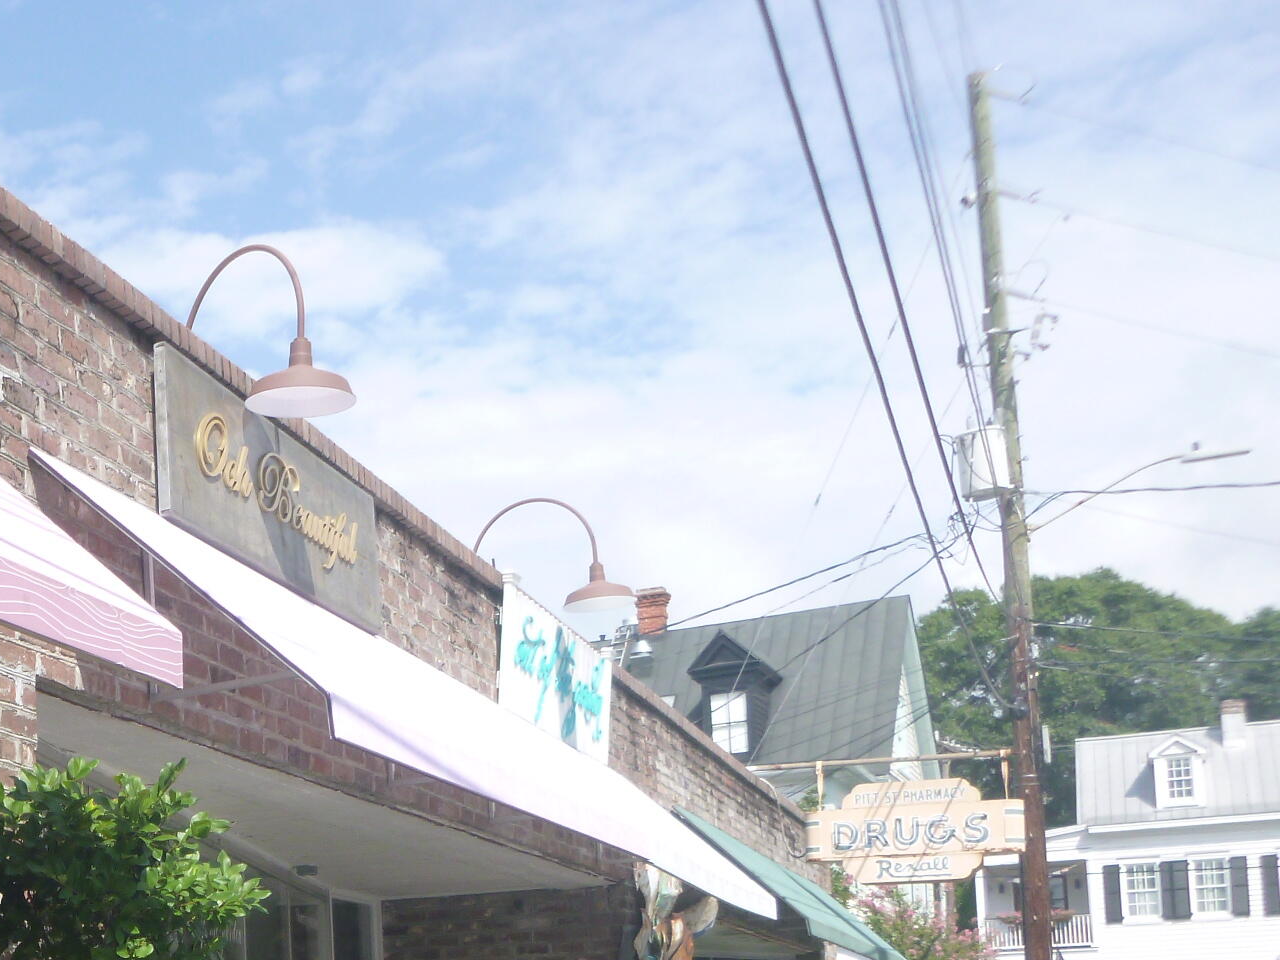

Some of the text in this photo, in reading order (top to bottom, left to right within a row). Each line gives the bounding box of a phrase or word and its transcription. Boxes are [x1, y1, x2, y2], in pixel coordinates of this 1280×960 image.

[854, 793, 879, 805] PITT
[903, 786, 966, 802] PHARMACY
[832, 813, 990, 851] DRUGS
[875, 856, 951, 880] Rexall
